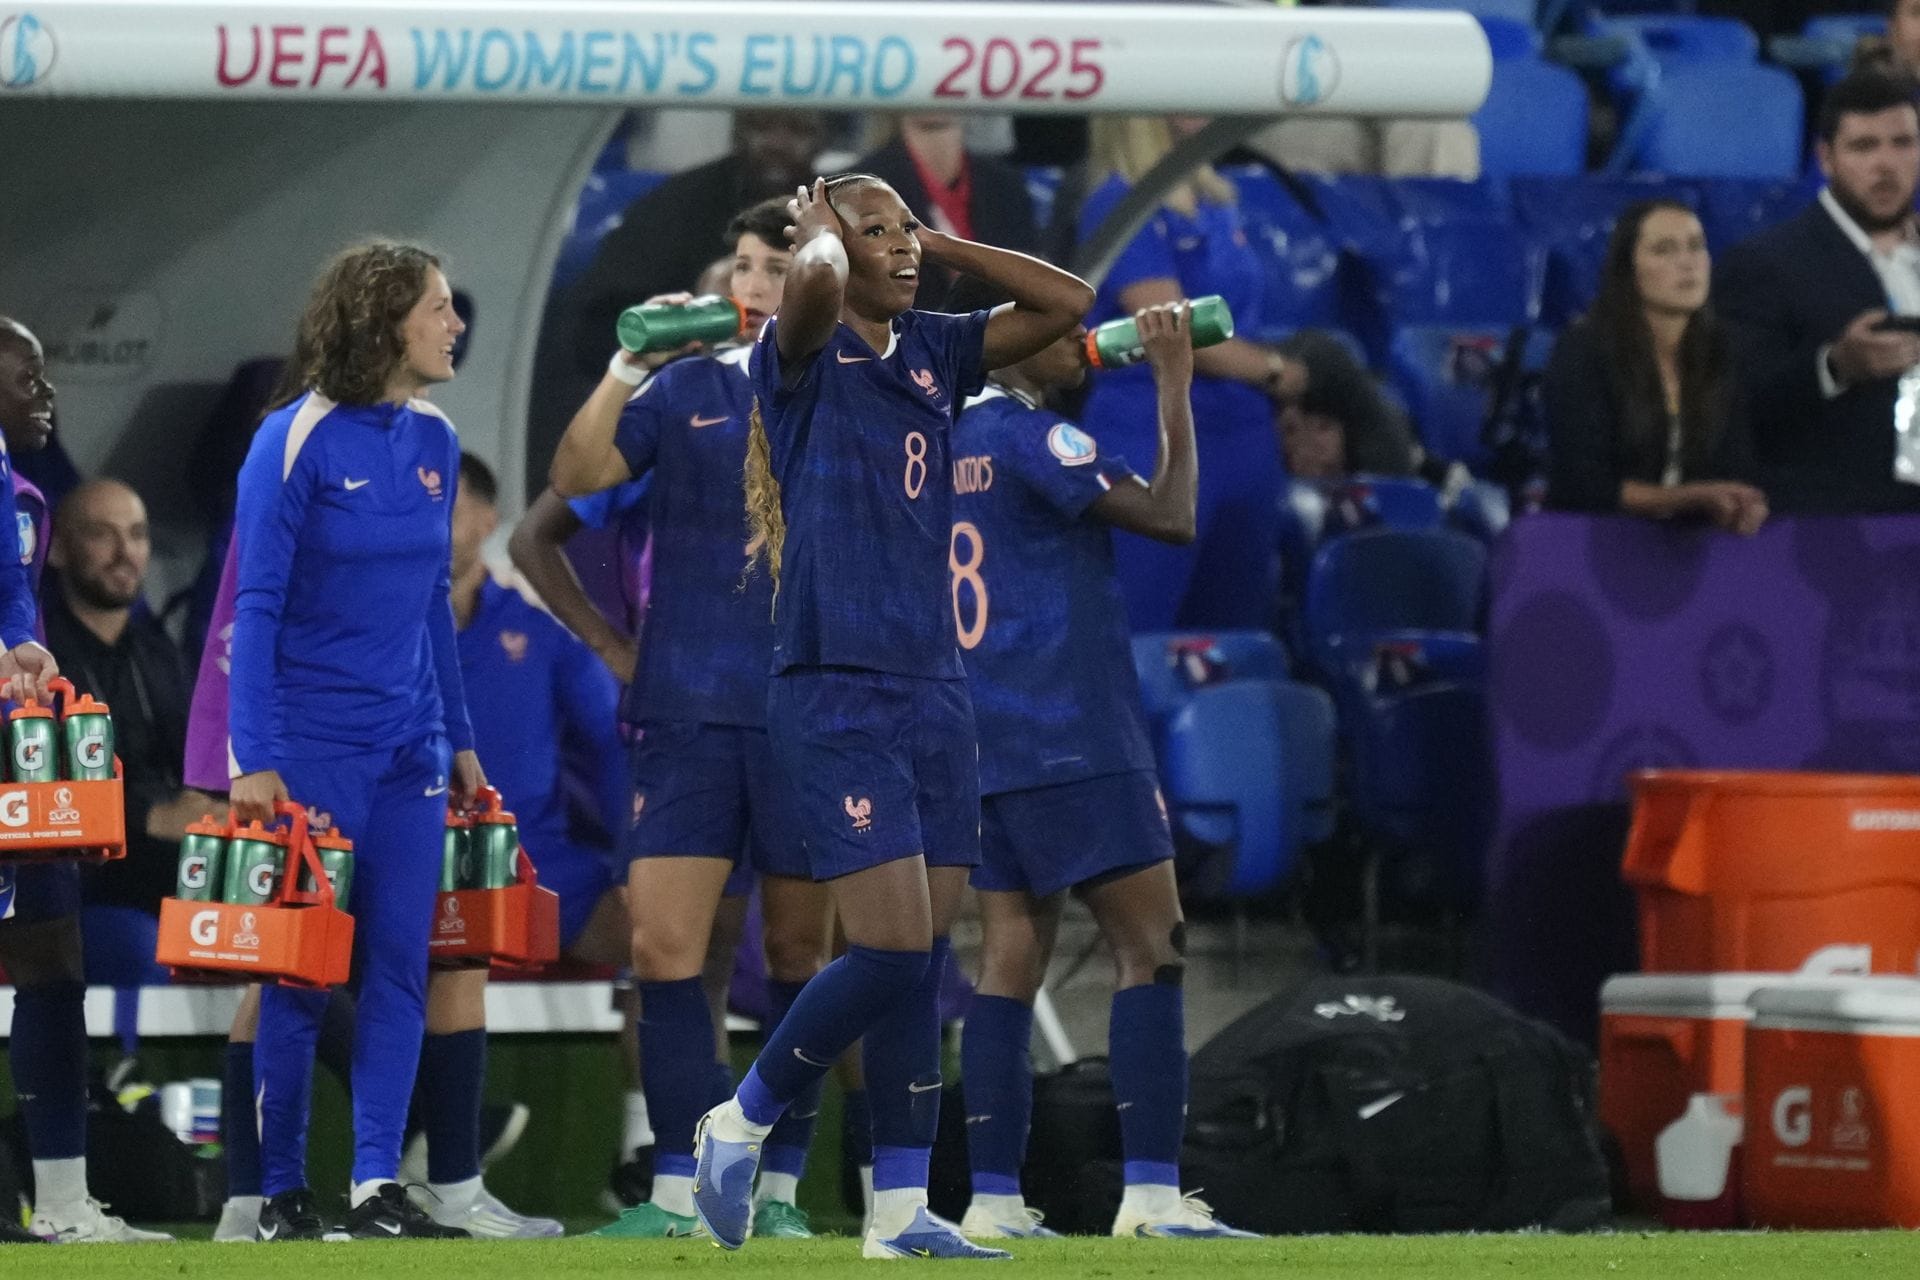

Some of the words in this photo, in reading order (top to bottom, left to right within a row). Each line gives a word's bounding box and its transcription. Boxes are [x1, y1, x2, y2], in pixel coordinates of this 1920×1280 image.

[216, 26, 388, 89] UEFA
[411, 27, 718, 94] WOMEN'S
[739, 34, 916, 97] EURO
[932, 37, 1105, 100] 2025
[904, 431, 927, 499] 8
[15, 738, 43, 771] G
[76, 735, 105, 769] G
[0, 791, 29, 827] G
[181, 856, 208, 889] G
[248, 863, 275, 896] G
[190, 910, 219, 946] G
[1772, 1087, 1812, 1147] G
